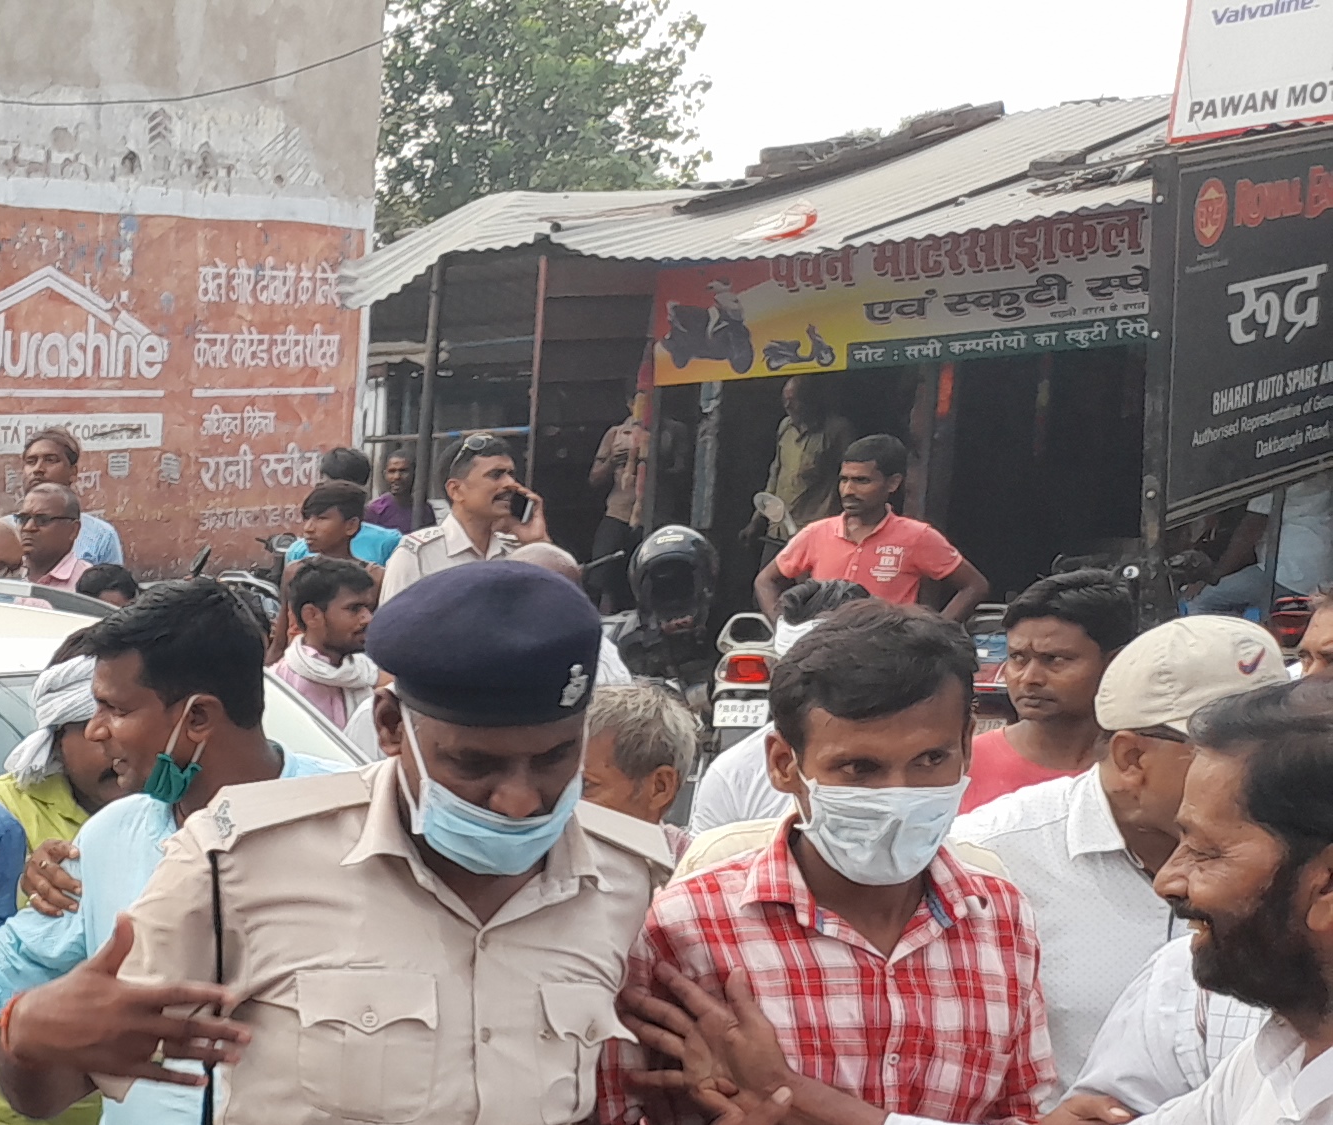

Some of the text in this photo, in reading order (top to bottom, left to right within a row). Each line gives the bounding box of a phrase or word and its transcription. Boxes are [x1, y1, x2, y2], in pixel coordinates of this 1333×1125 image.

[1188, 88, 1278, 122] PAWAN
[1234, 177, 1303, 227] ROYAL
[229, 257, 255, 305] और
[863, 288, 936, 324] एवं
[943, 273, 1072, 321] स्कुटी
[194, 332, 230, 368] कलर
[231, 325, 270, 370] कोटेड
[852, 345, 886, 364] नोट
[903, 339, 942, 359] सभी
[1033, 331, 1058, 347] का
[1065, 321, 1109, 349] स्कुटी
[1212, 381, 1255, 416] BHARAT
[1255, 374, 1285, 403] AUTO
[1285, 364, 1319, 395] SPARE
[199, 442, 255, 491] रानी
[875, 545, 904, 555] NEW
